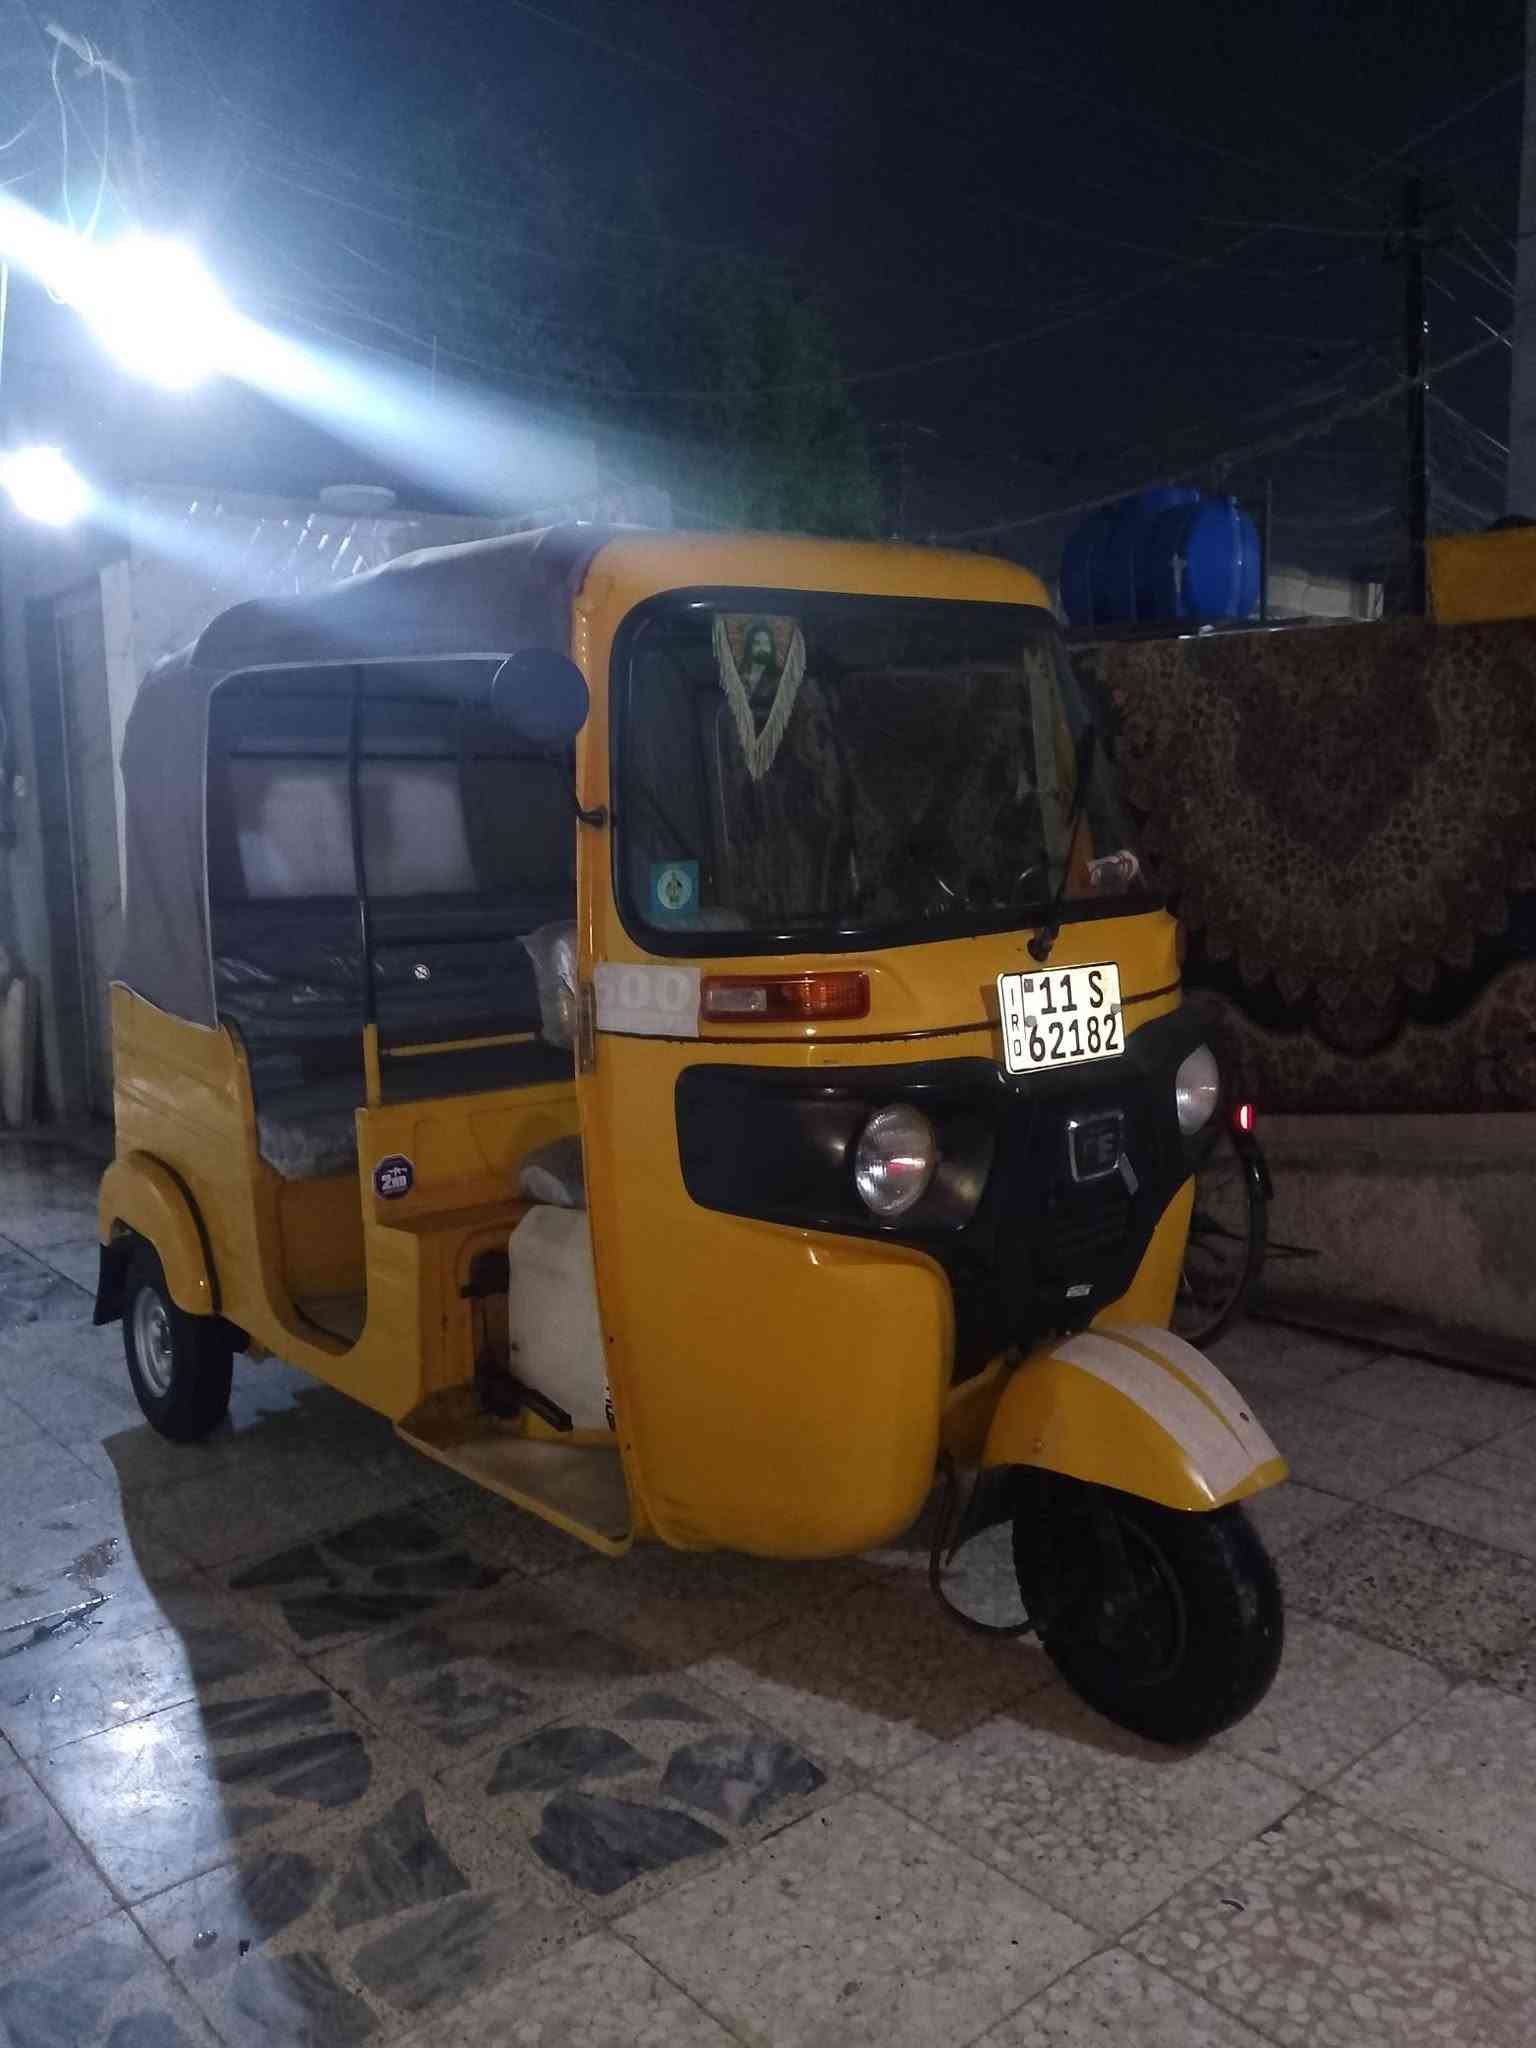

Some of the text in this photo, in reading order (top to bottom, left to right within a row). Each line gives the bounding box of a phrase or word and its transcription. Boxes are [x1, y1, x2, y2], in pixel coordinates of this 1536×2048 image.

[1039, 970, 1104, 1015] 11 S
[1029, 1014, 1118, 1062] 62182
